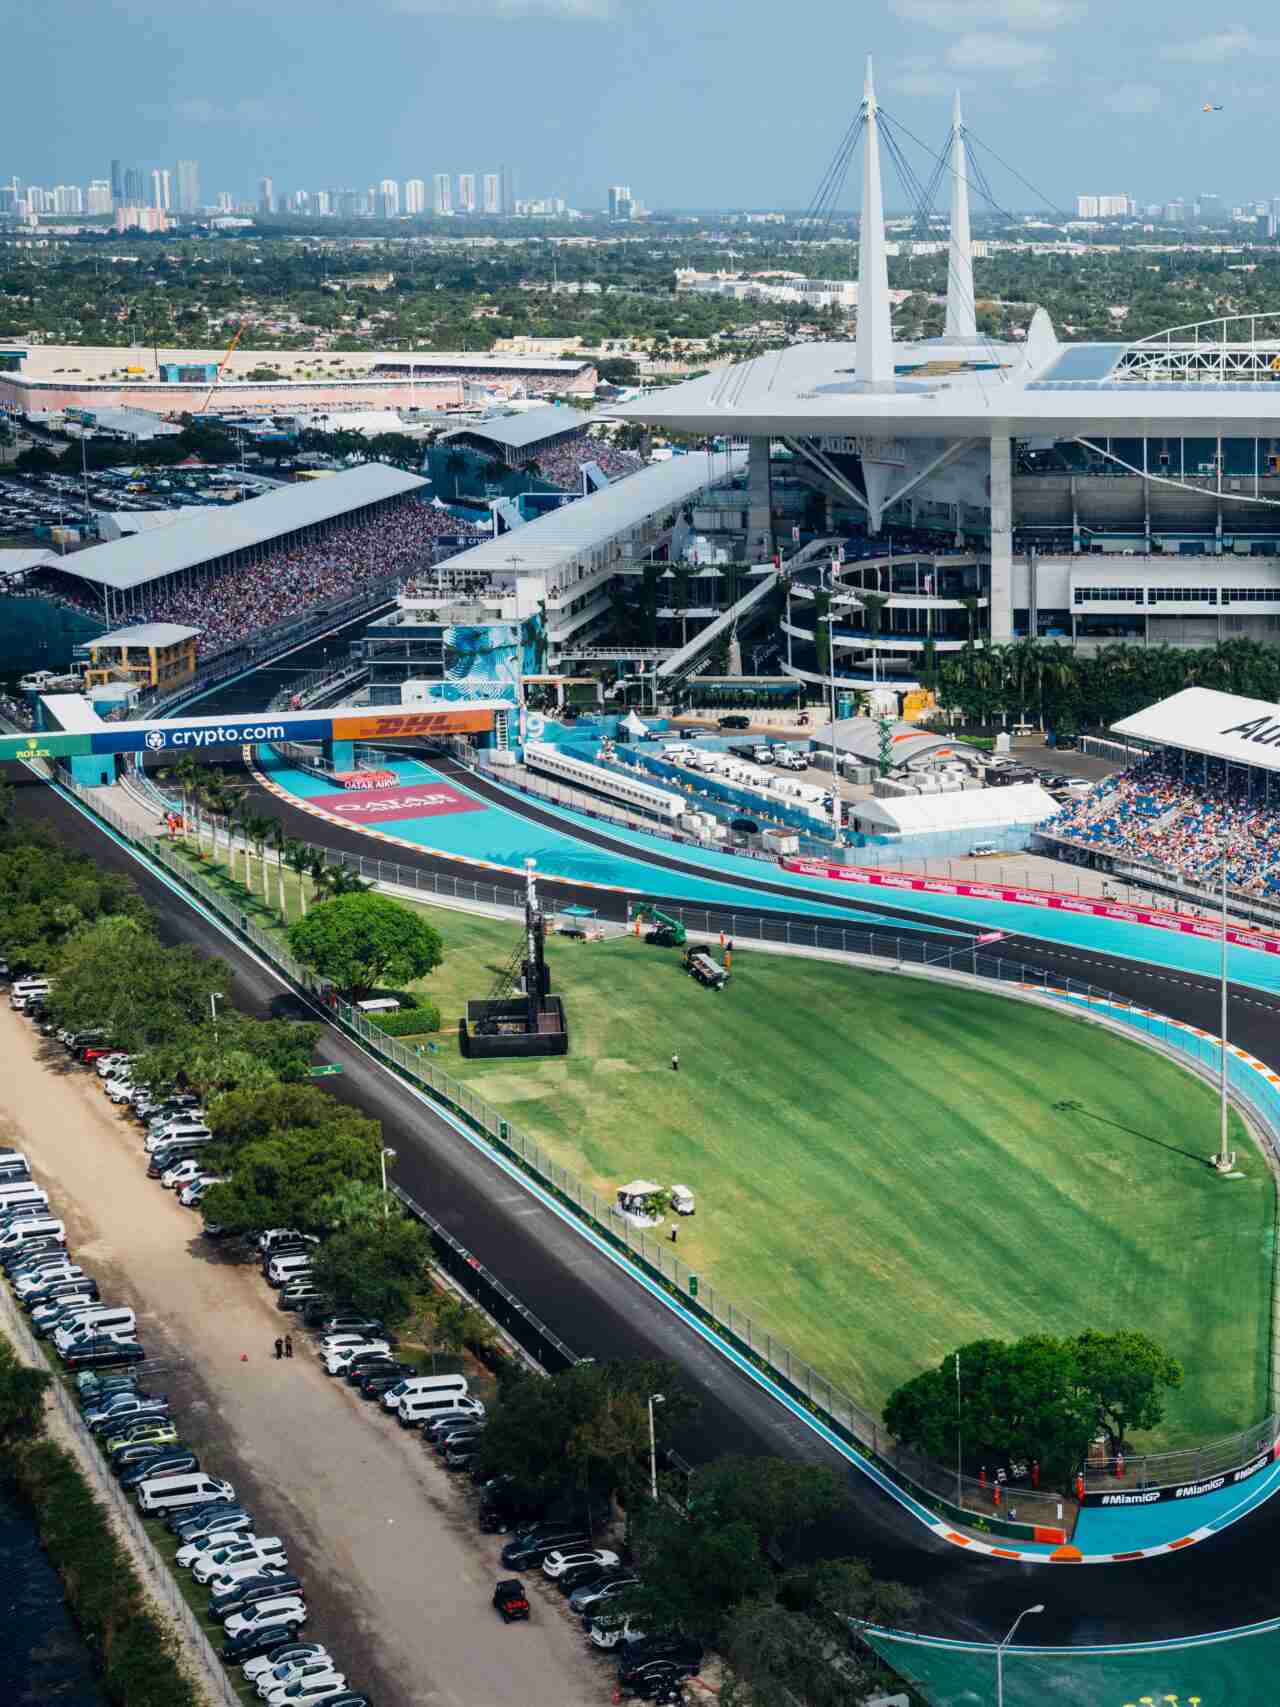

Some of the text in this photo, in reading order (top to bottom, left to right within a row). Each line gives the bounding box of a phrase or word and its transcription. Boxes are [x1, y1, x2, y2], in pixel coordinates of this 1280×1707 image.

[376, 715, 449, 734] DHL
[526, 711, 543, 737] 9
[171, 724, 285, 749] crypto.com
[16, 750, 49, 759] ROLEX
[334, 793, 457, 812] QATAR
[1176, 1477, 1225, 1499] #MiamiGP
[1102, 1492, 1161, 1505] #MiamiGP
